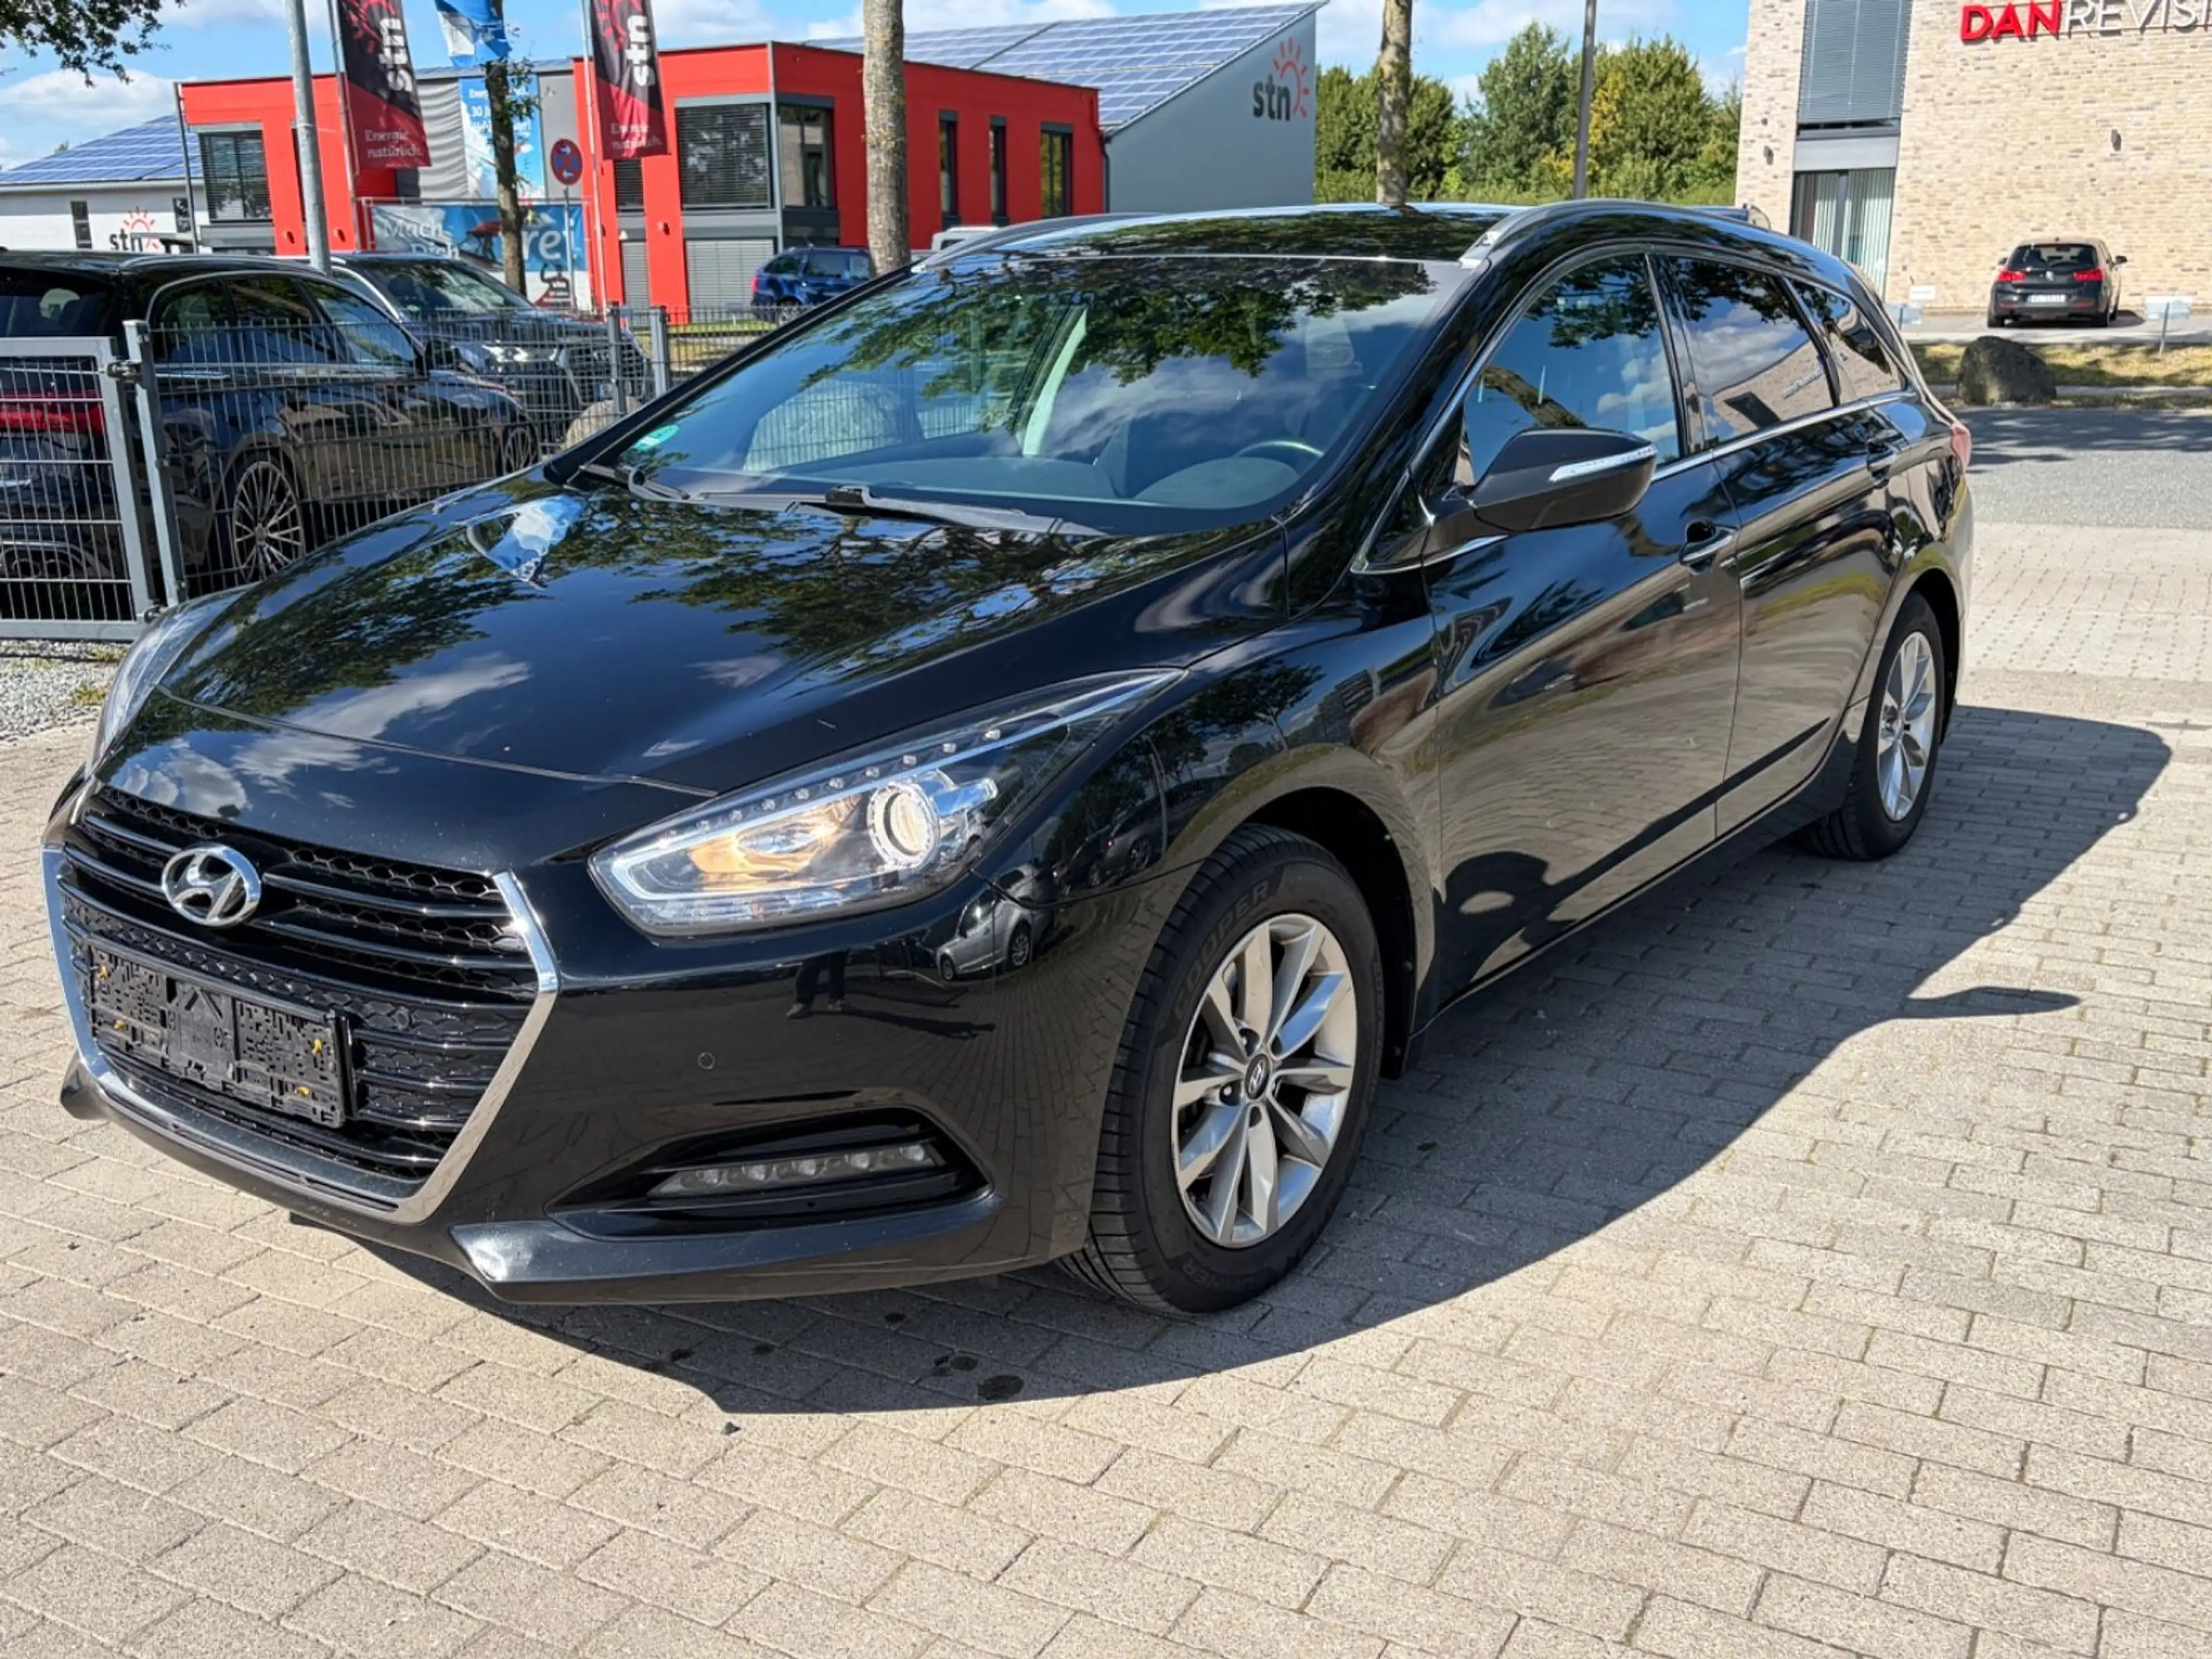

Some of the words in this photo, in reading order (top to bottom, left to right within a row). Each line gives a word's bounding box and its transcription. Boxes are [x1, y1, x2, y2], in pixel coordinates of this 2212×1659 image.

[378, 18, 413, 91] stn
[626, 15, 656, 86] stn
[1253, 74, 1291, 122] stn
[109, 228, 143, 252] stn
[1174, 879, 1269, 1021] COOPER
